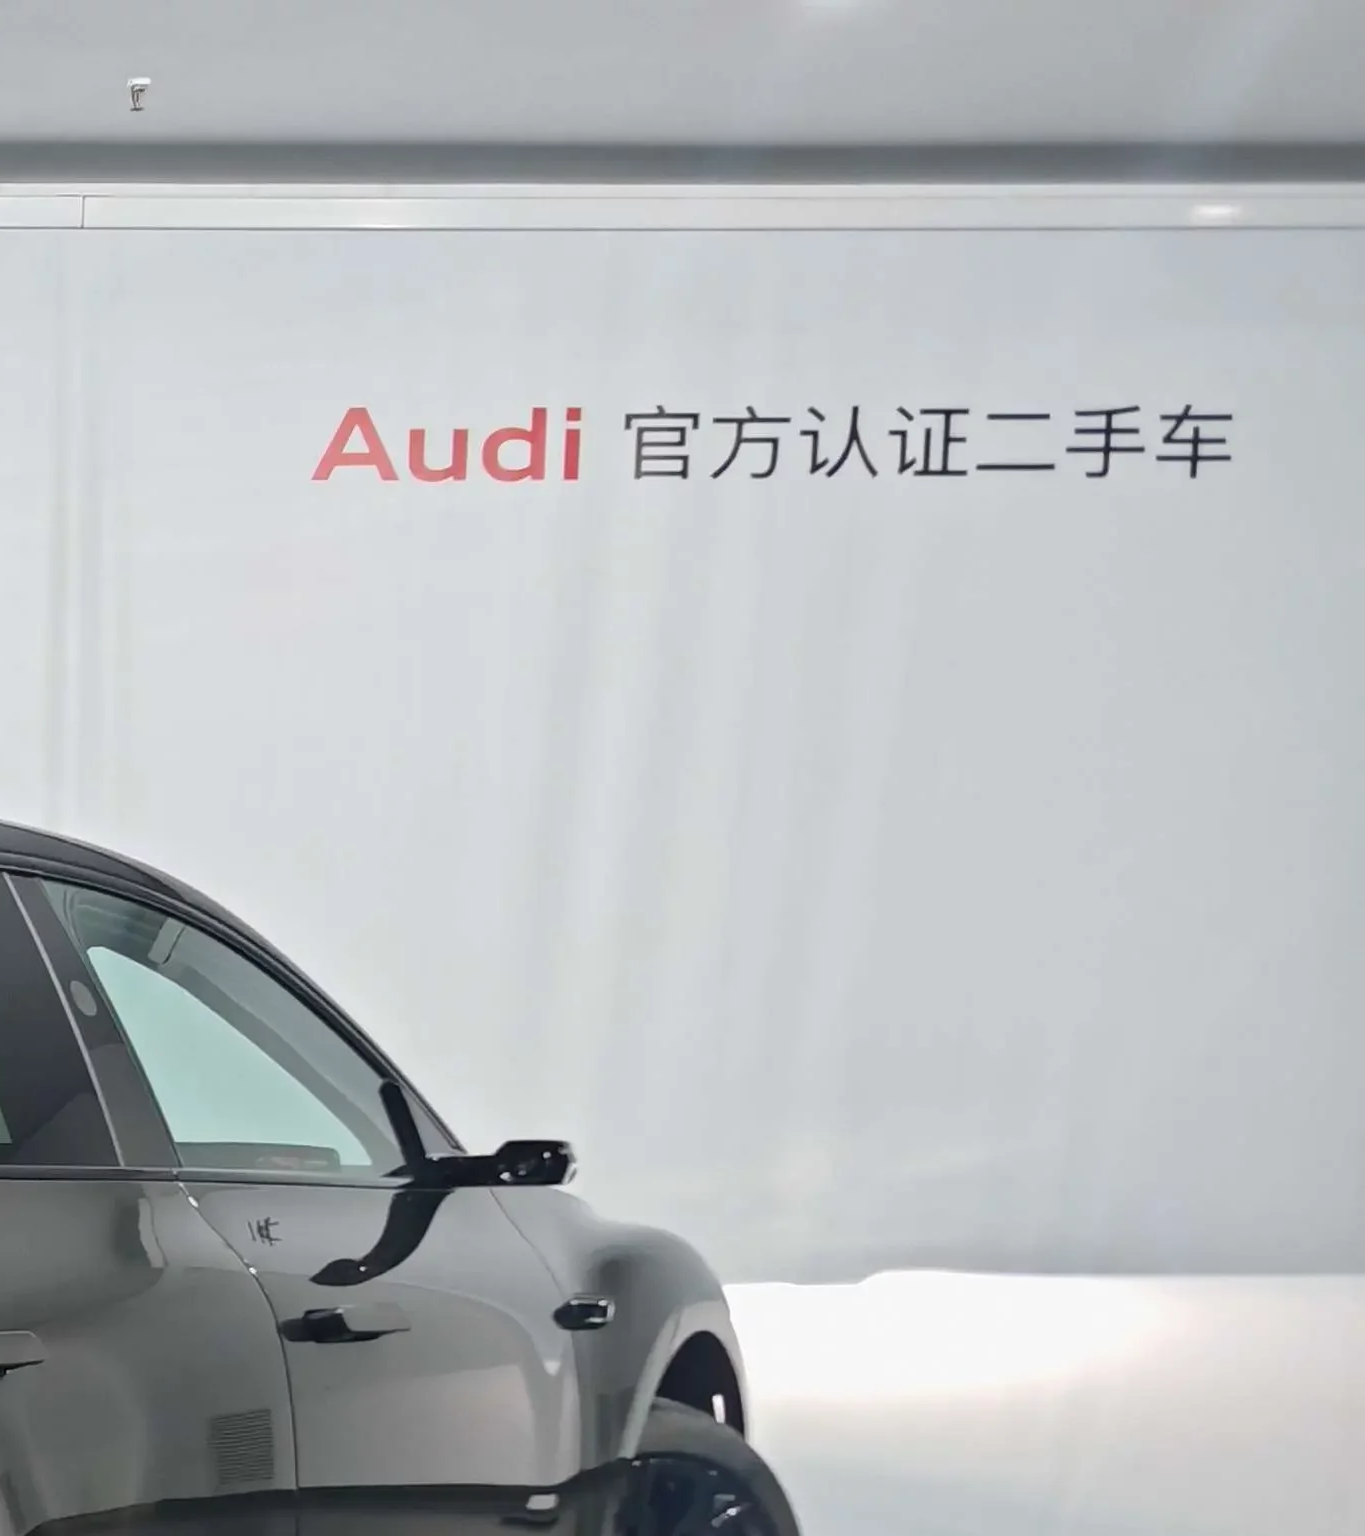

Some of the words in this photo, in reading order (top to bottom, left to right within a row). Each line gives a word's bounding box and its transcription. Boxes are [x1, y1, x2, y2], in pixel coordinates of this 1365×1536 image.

[311, 406, 583, 483] Audi
[623, 403, 1235, 481] 官方认证二手车
